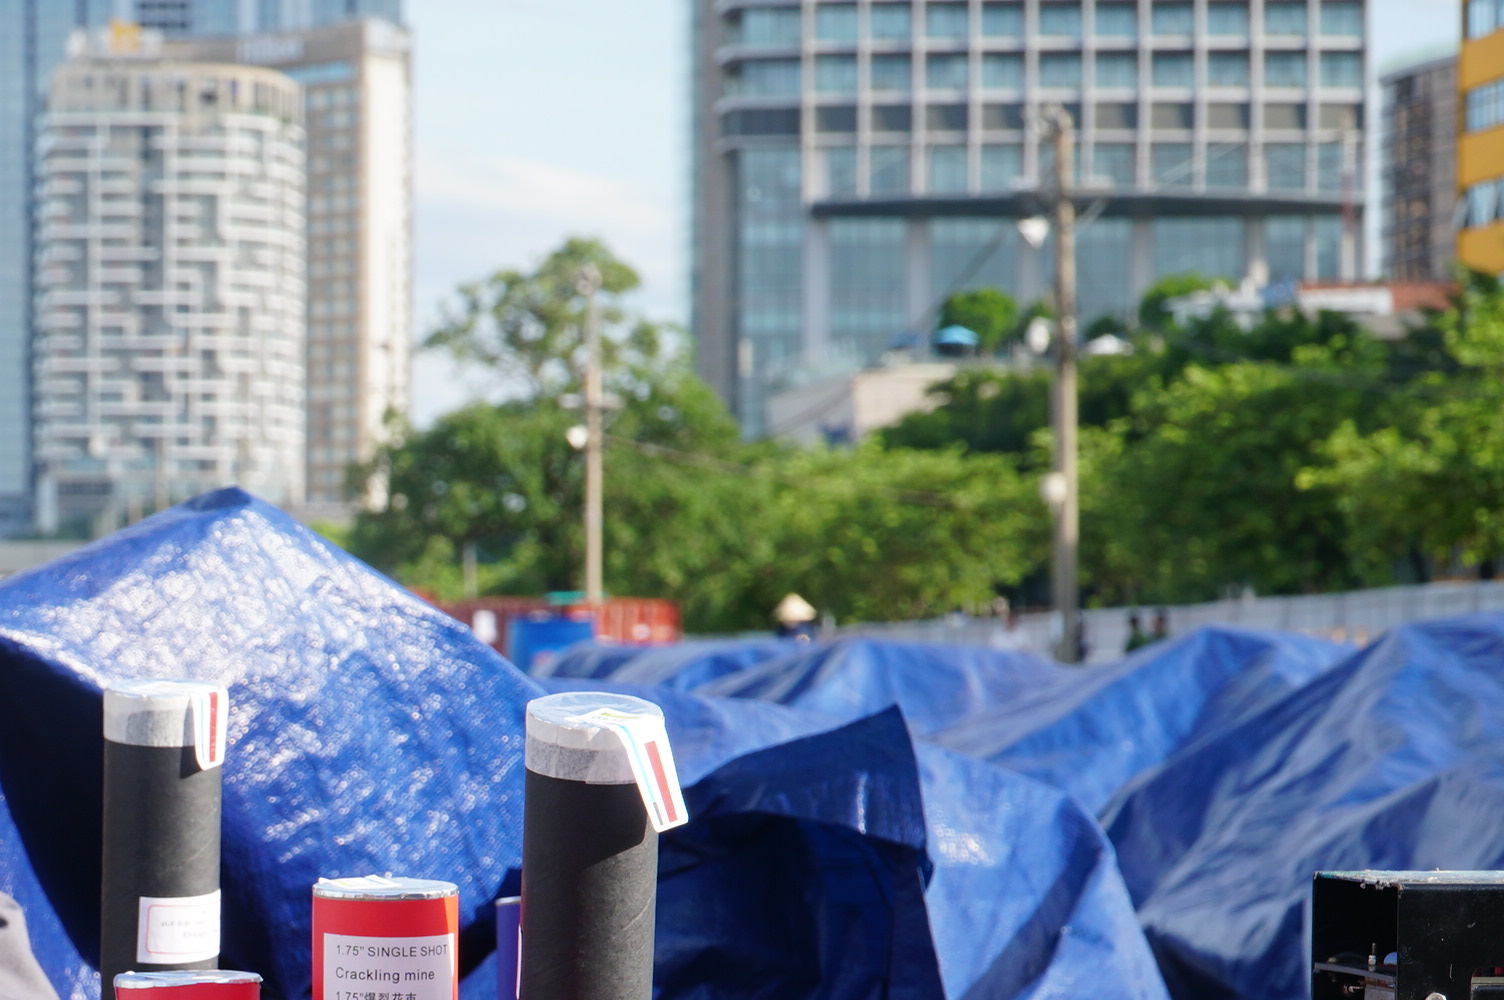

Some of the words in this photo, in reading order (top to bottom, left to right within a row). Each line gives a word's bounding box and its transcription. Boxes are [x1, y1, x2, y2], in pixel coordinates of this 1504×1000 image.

[336, 944, 365, 957] 1.75"
[367, 946, 417, 958] SINGLE
[420, 944, 448, 957] SHOT
[335, 966, 400, 984] Crackling
[404, 969, 435, 981] mine
